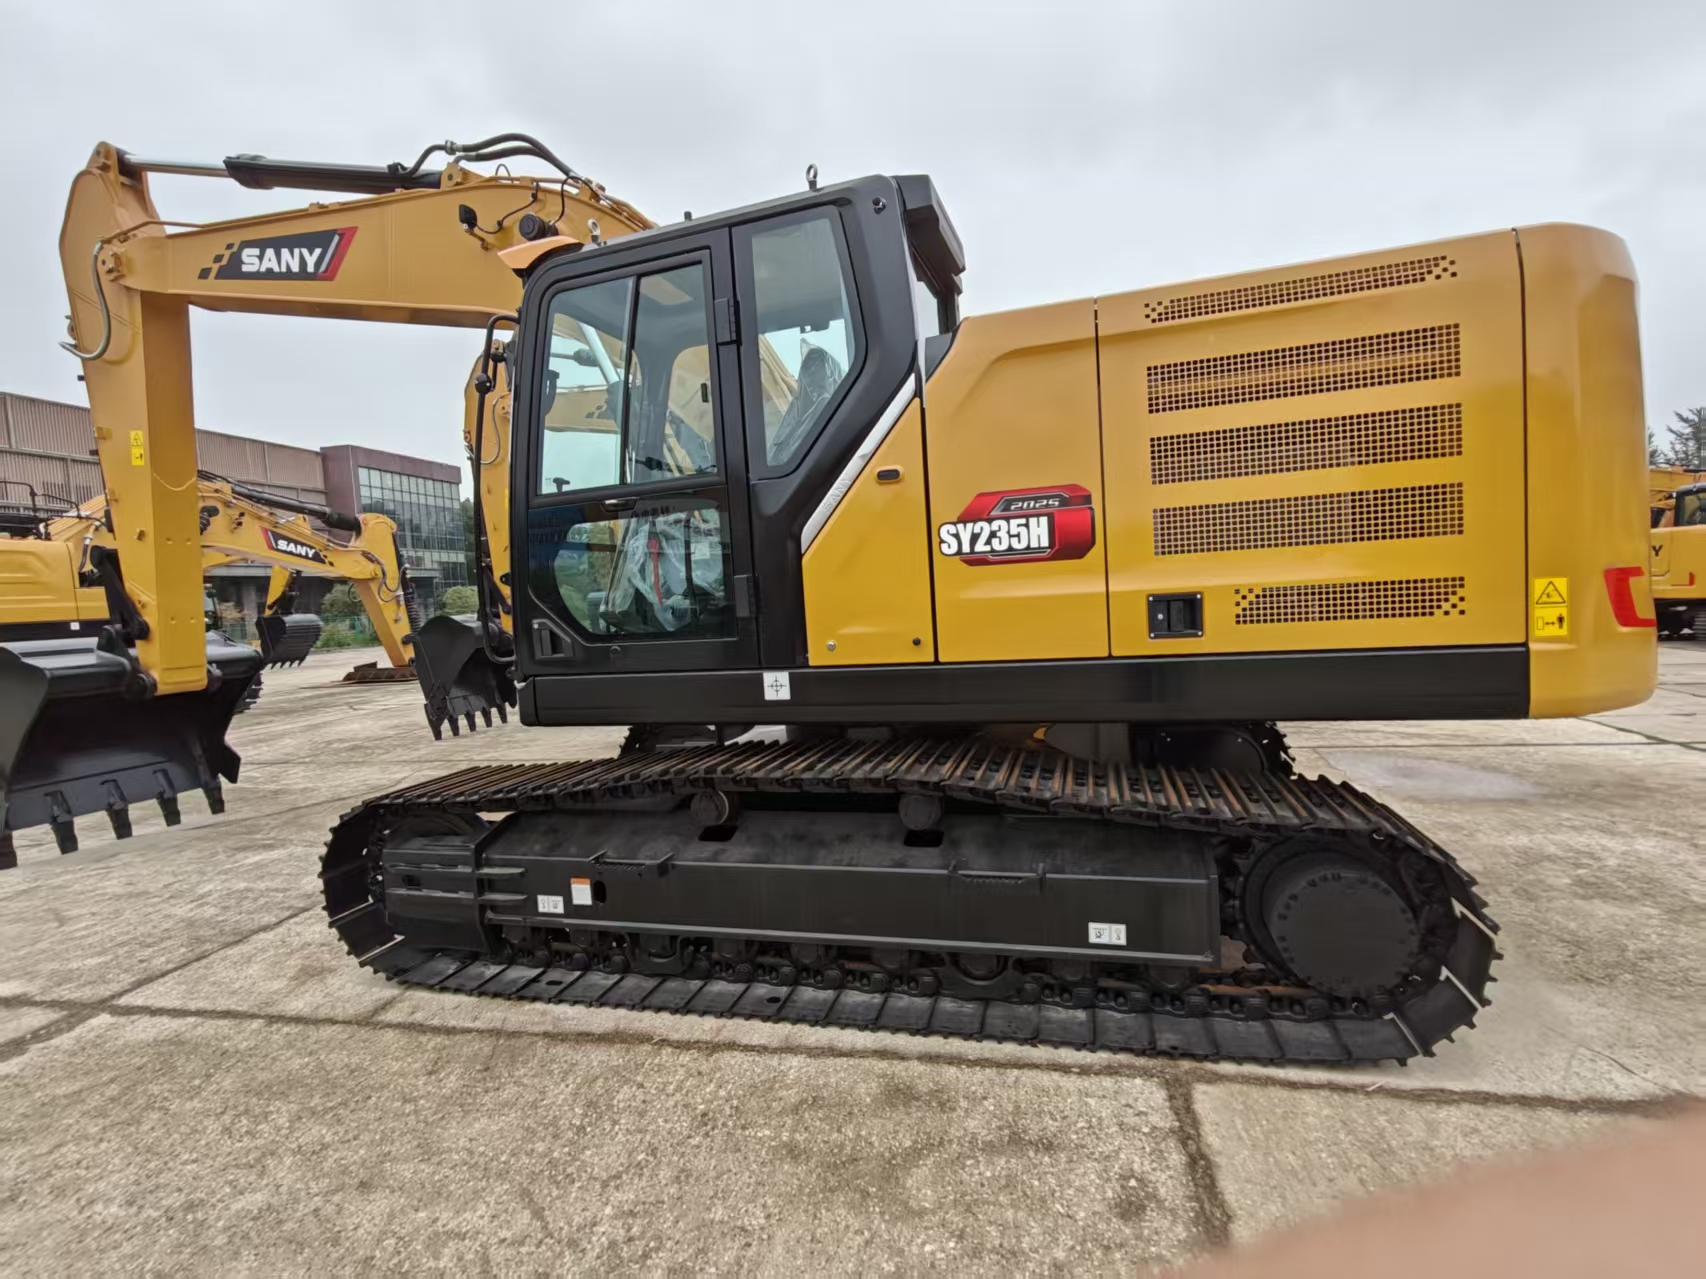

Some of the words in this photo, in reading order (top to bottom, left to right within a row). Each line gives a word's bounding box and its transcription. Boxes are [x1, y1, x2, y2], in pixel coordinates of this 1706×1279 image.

[240, 247, 323, 273] SANY
[822, 472, 852, 513] SANY
[1010, 498, 1061, 511] 2025
[277, 539, 316, 558] SANY
[939, 515, 1050, 556] SY235H
